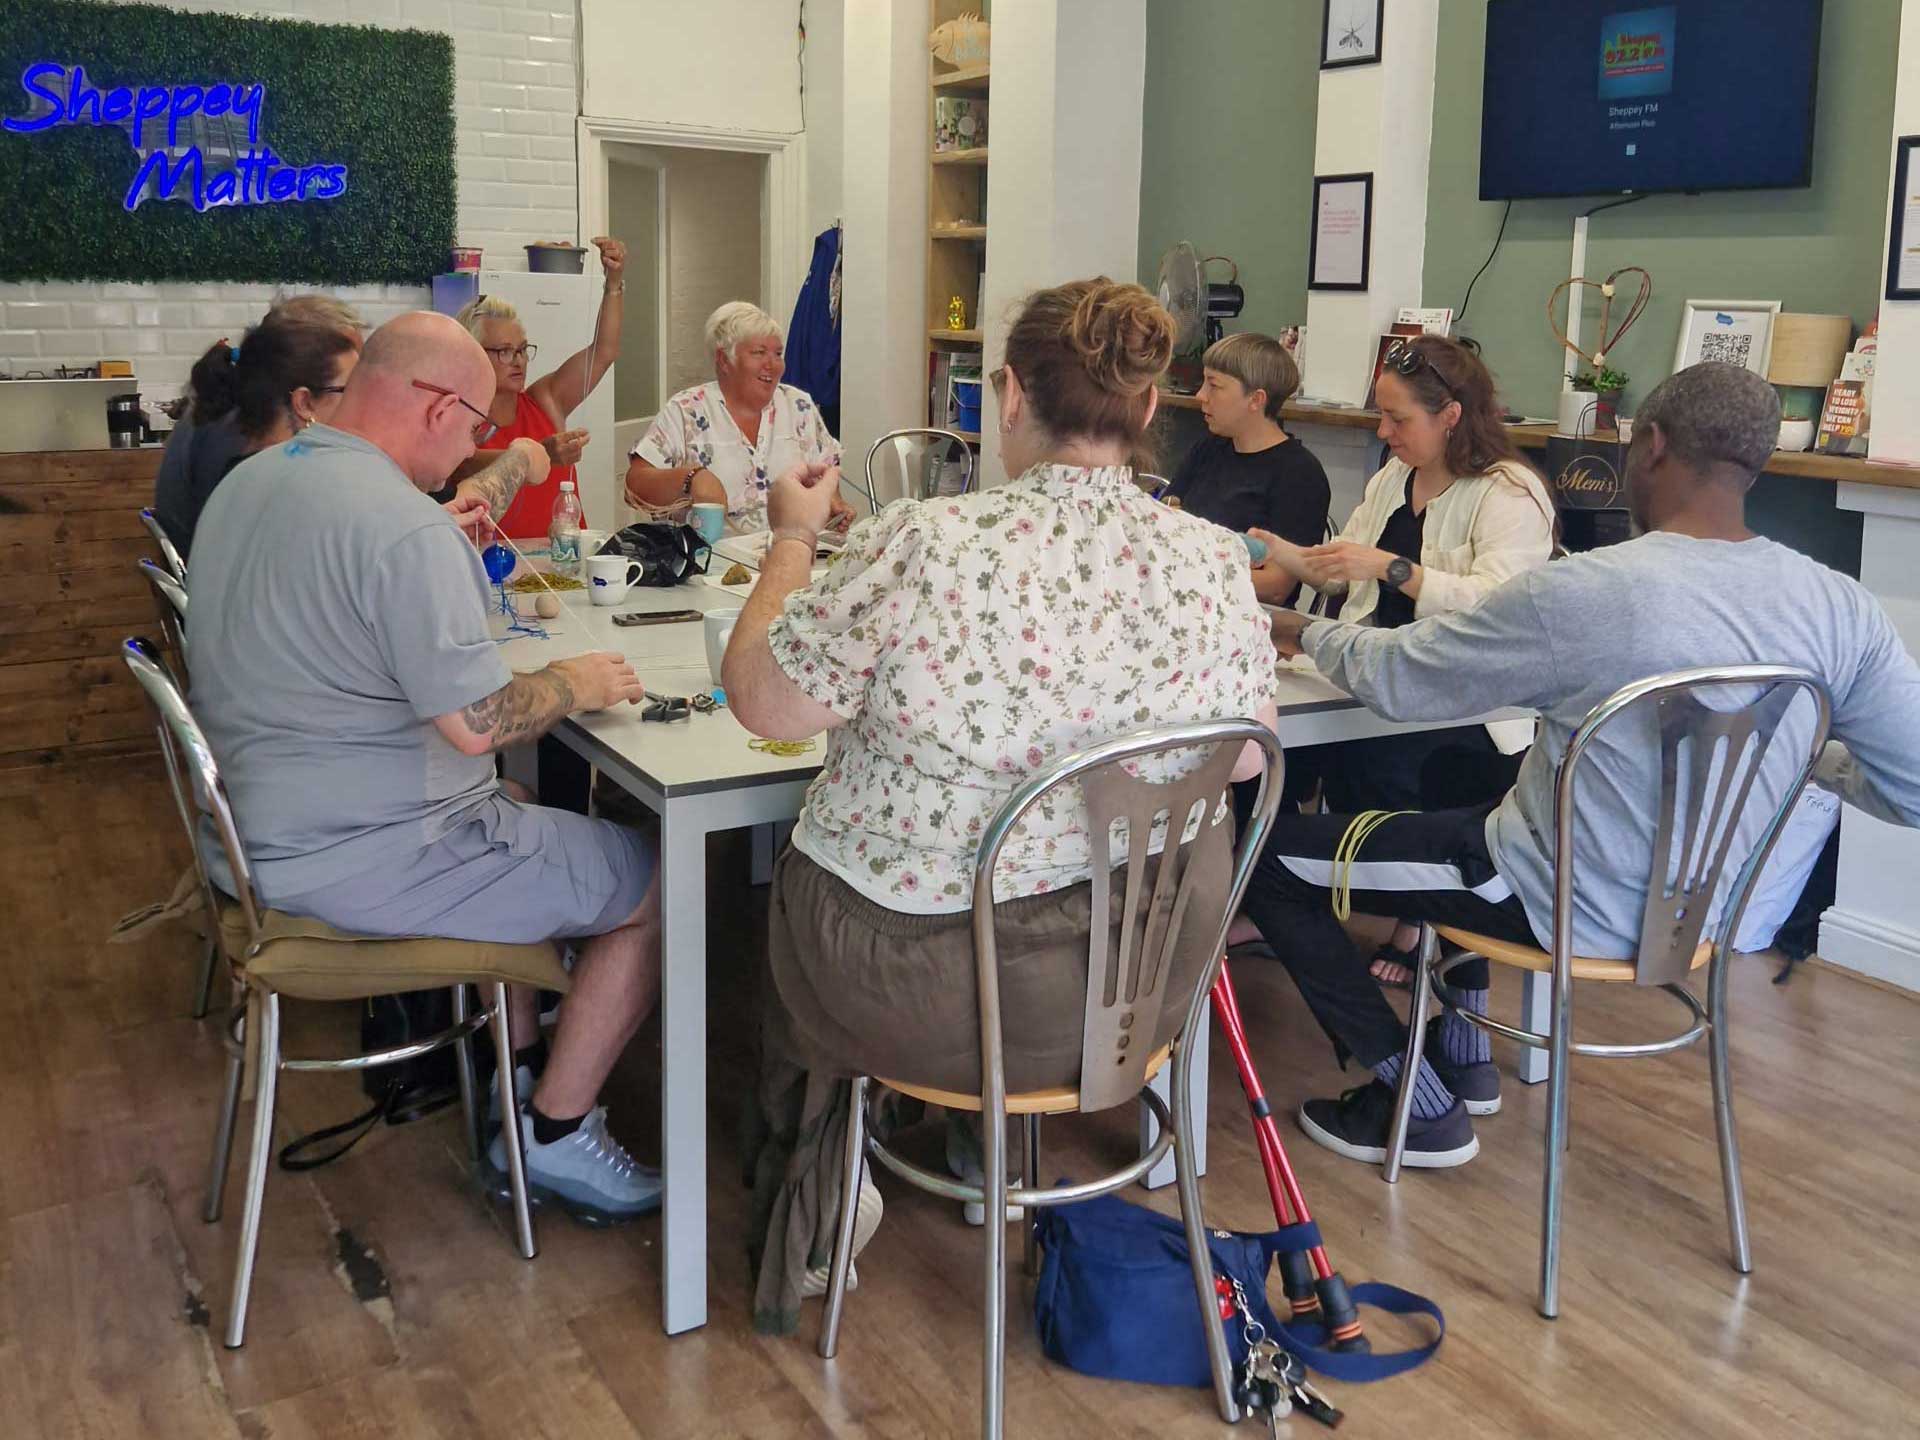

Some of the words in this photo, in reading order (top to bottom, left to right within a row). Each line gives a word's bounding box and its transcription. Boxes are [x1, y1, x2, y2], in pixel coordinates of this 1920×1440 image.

[3, 62, 263, 148] Sheppey
[1608, 106, 1643, 117] Sheppey
[1644, 103, 1659, 113] FM
[126, 146, 347, 209] Matters
[1833, 388, 1856, 397] READY
[1831, 397, 1840, 405] TO
[1840, 397, 1857, 406] LOSE
[1829, 406, 1859, 416] WEIGHT?
[1826, 414, 1837, 423] WE
[1837, 415, 1852, 424] CAN
[1822, 424, 1840, 432] HELP
